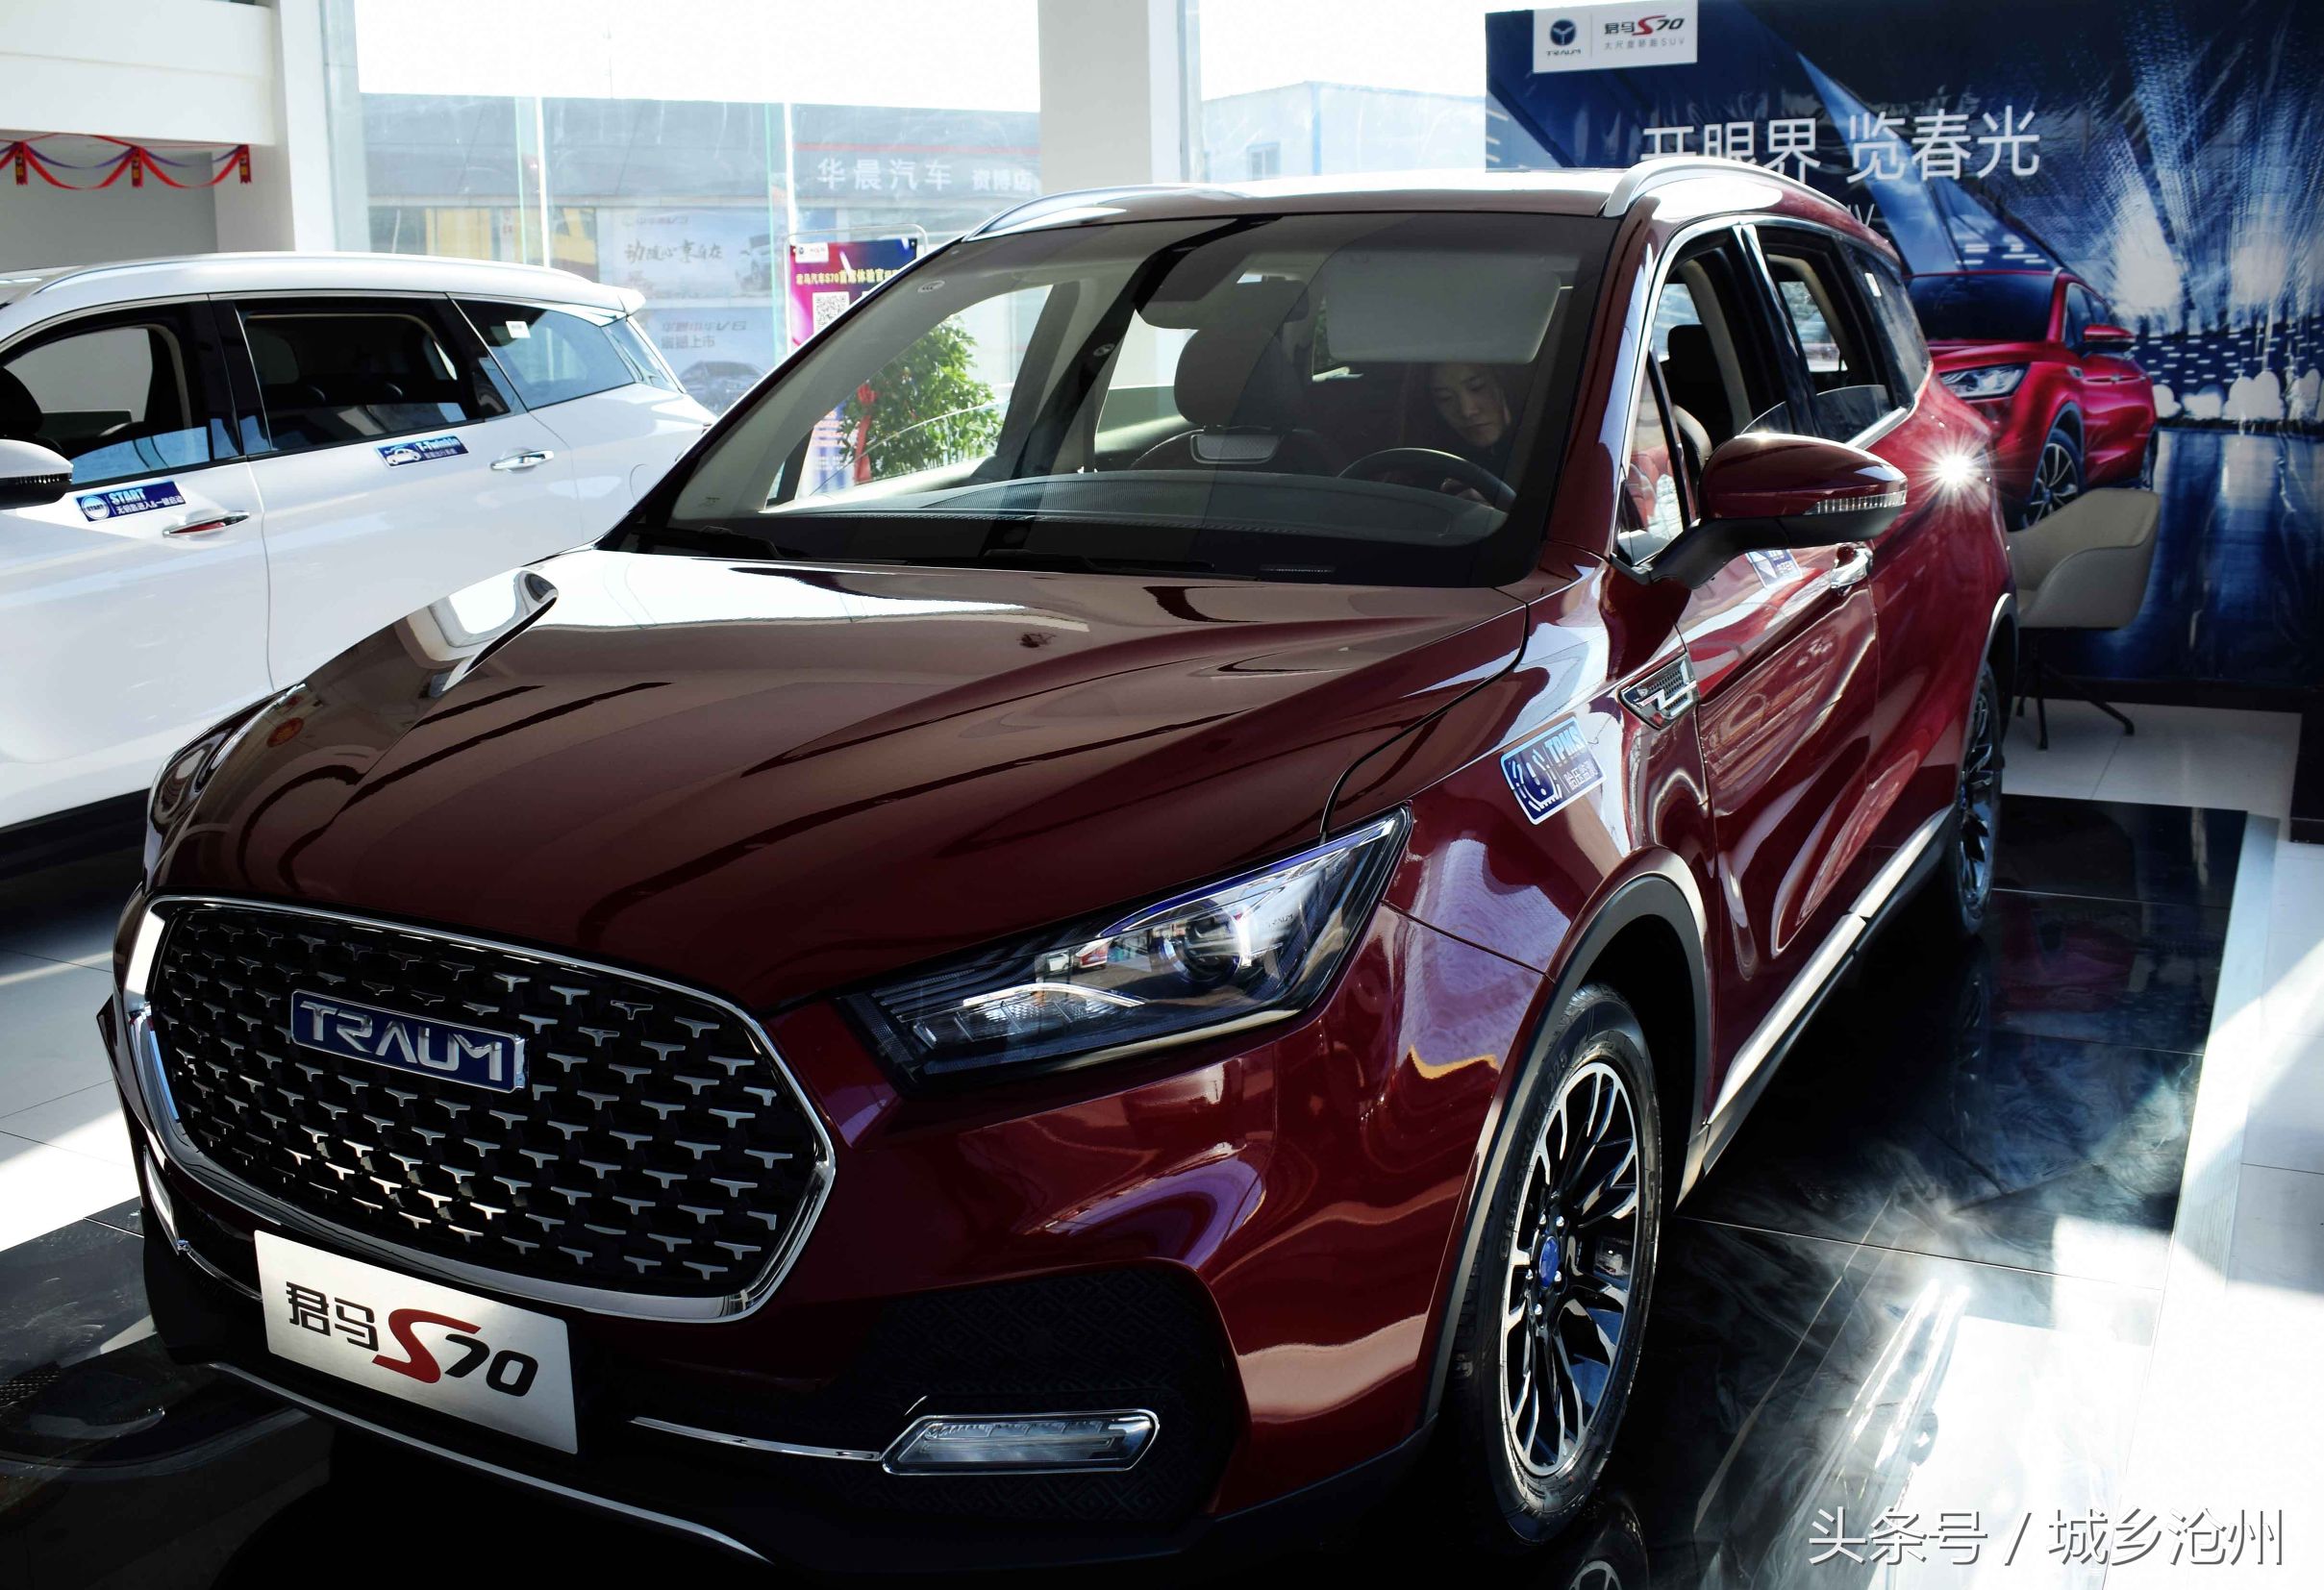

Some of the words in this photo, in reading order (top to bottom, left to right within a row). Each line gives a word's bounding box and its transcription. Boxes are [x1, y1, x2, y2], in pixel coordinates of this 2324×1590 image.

[1846, 105, 2040, 184] 览春光
[816, 158, 953, 192] 华晨汽车
[108, 488, 147, 506] START
[1544, 726, 1587, 763] TPMS
[300, 1000, 503, 1081] TRAUM
[286, 1280, 539, 1398] 君马S70
